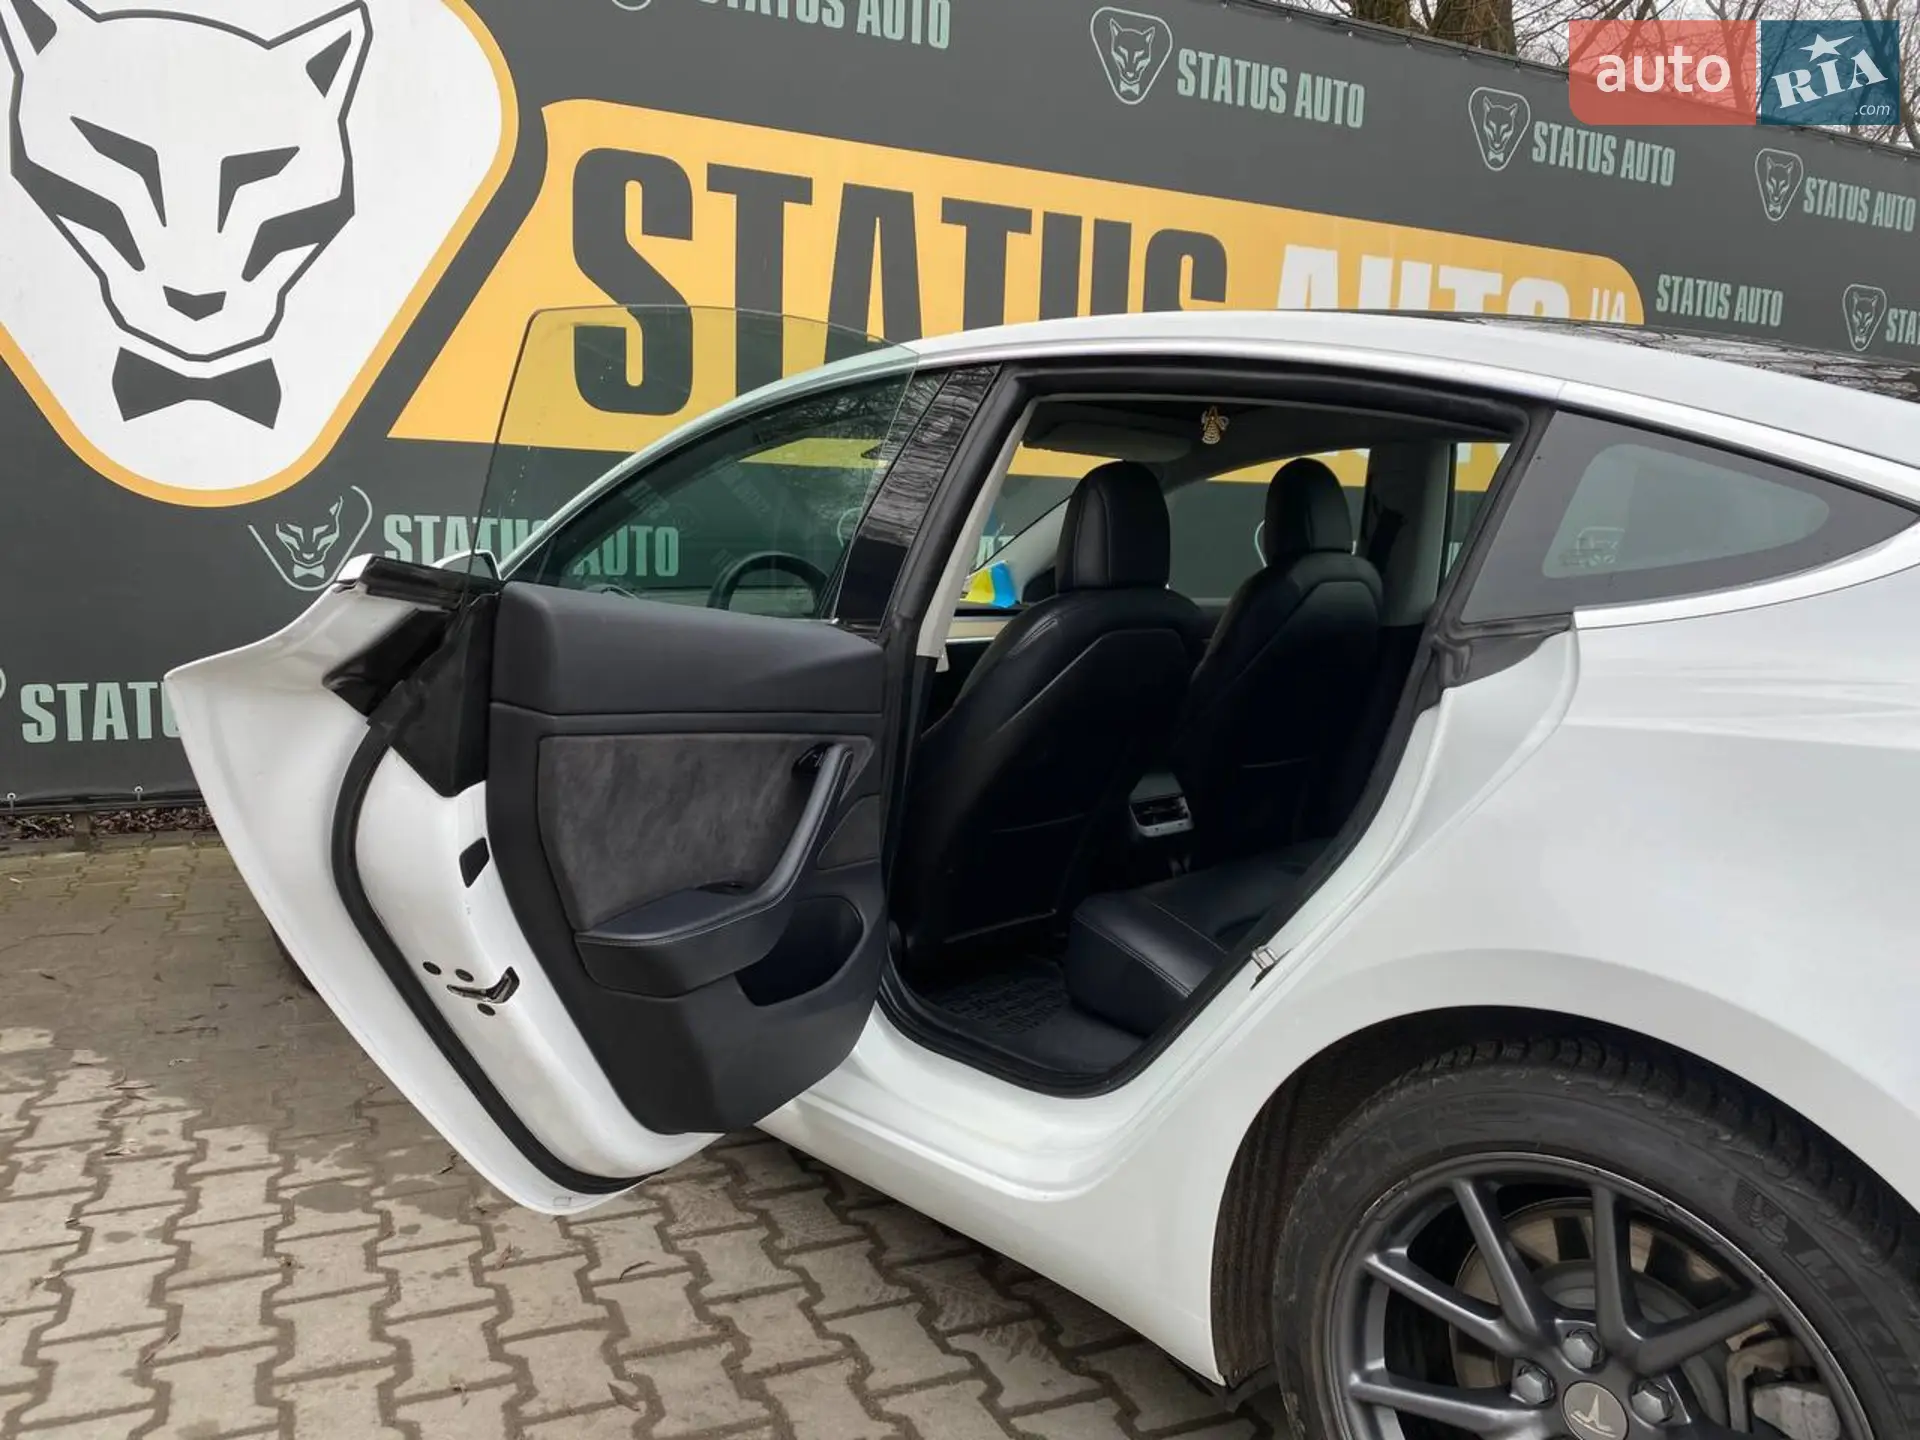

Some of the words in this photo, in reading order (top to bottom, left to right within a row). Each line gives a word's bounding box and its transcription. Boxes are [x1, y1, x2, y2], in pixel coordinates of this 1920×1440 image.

[857, 0, 950, 49] AUTO
[1177, 48, 1288, 114] STATUS
[1294, 72, 1365, 128] AUTO
[1532, 121, 1617, 176] STATUS
[1620, 138, 1676, 187] AUTO
[1803, 176, 1871, 224] STATUS
[1872, 191, 1916, 232] AUTO
[1656, 274, 1731, 320] STATUS
[1733, 287, 1784, 327] AUTO
[384, 514, 551, 567] STATU
